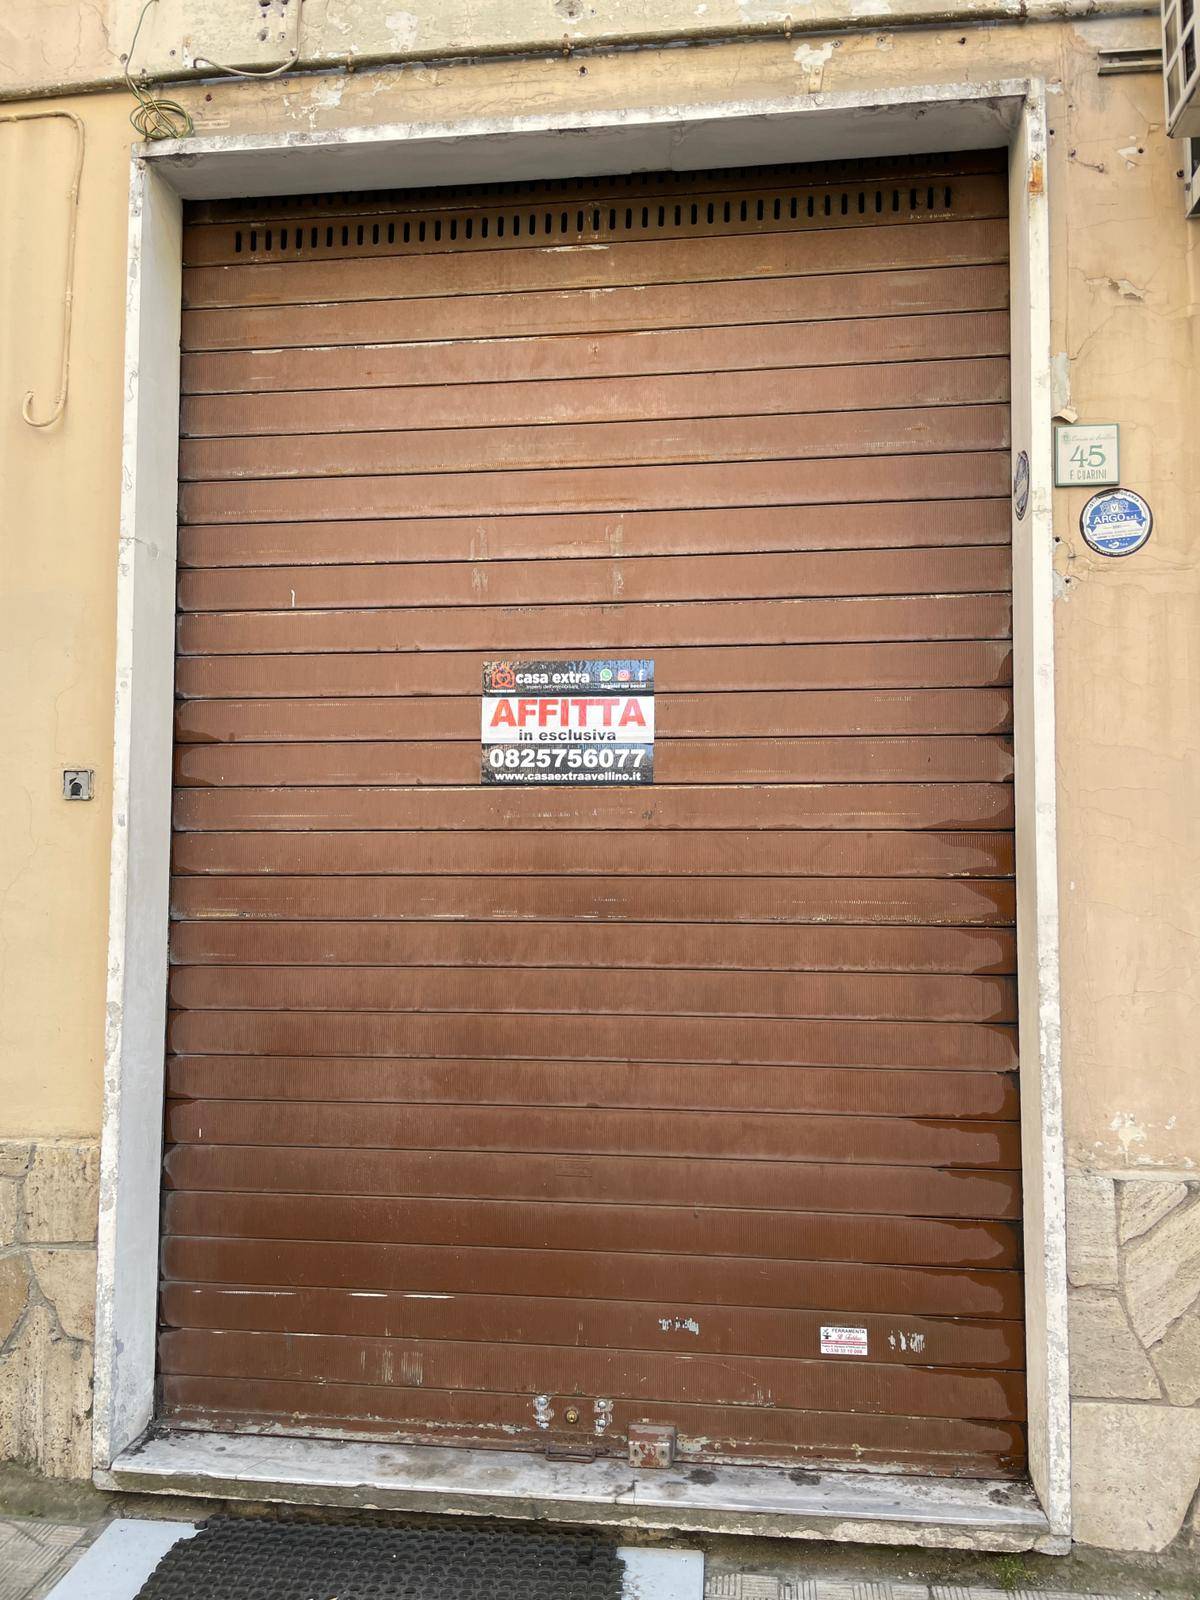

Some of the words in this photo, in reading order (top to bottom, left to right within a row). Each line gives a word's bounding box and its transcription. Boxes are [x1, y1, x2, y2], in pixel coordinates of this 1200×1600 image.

[1069, 445, 1106, 468] 45
[1093, 513, 1126, 525] ARGO
[515, 672, 549, 684] casa
[551, 671, 590, 684] extra
[490, 699, 647, 727] AFFITTA
[519, 729, 533, 741] in
[538, 729, 617, 741] esclusiva
[489, 748, 647, 768] 0825756077
[494, 771, 641, 781] www.casaextraavellino.it
